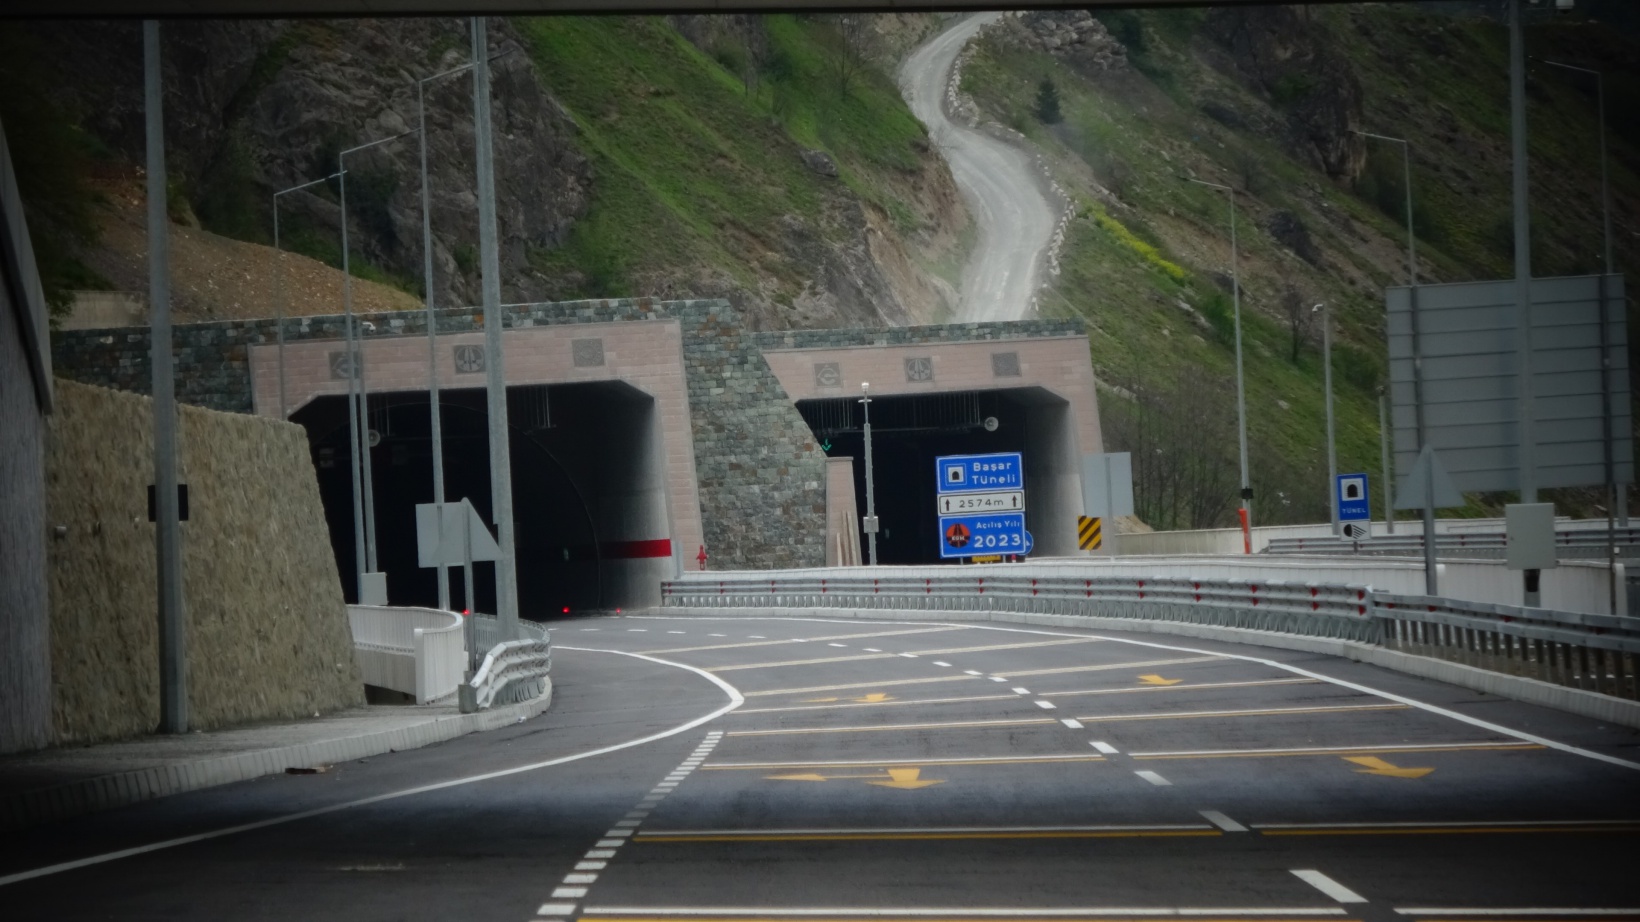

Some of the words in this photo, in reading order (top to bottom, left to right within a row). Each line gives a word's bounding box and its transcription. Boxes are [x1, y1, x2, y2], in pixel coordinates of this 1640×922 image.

[973, 462, 1012, 471] Başar
[972, 474, 1015, 484] Tüneli
[976, 521, 1002, 529] Açılış
[974, 534, 1021, 548] 2023
